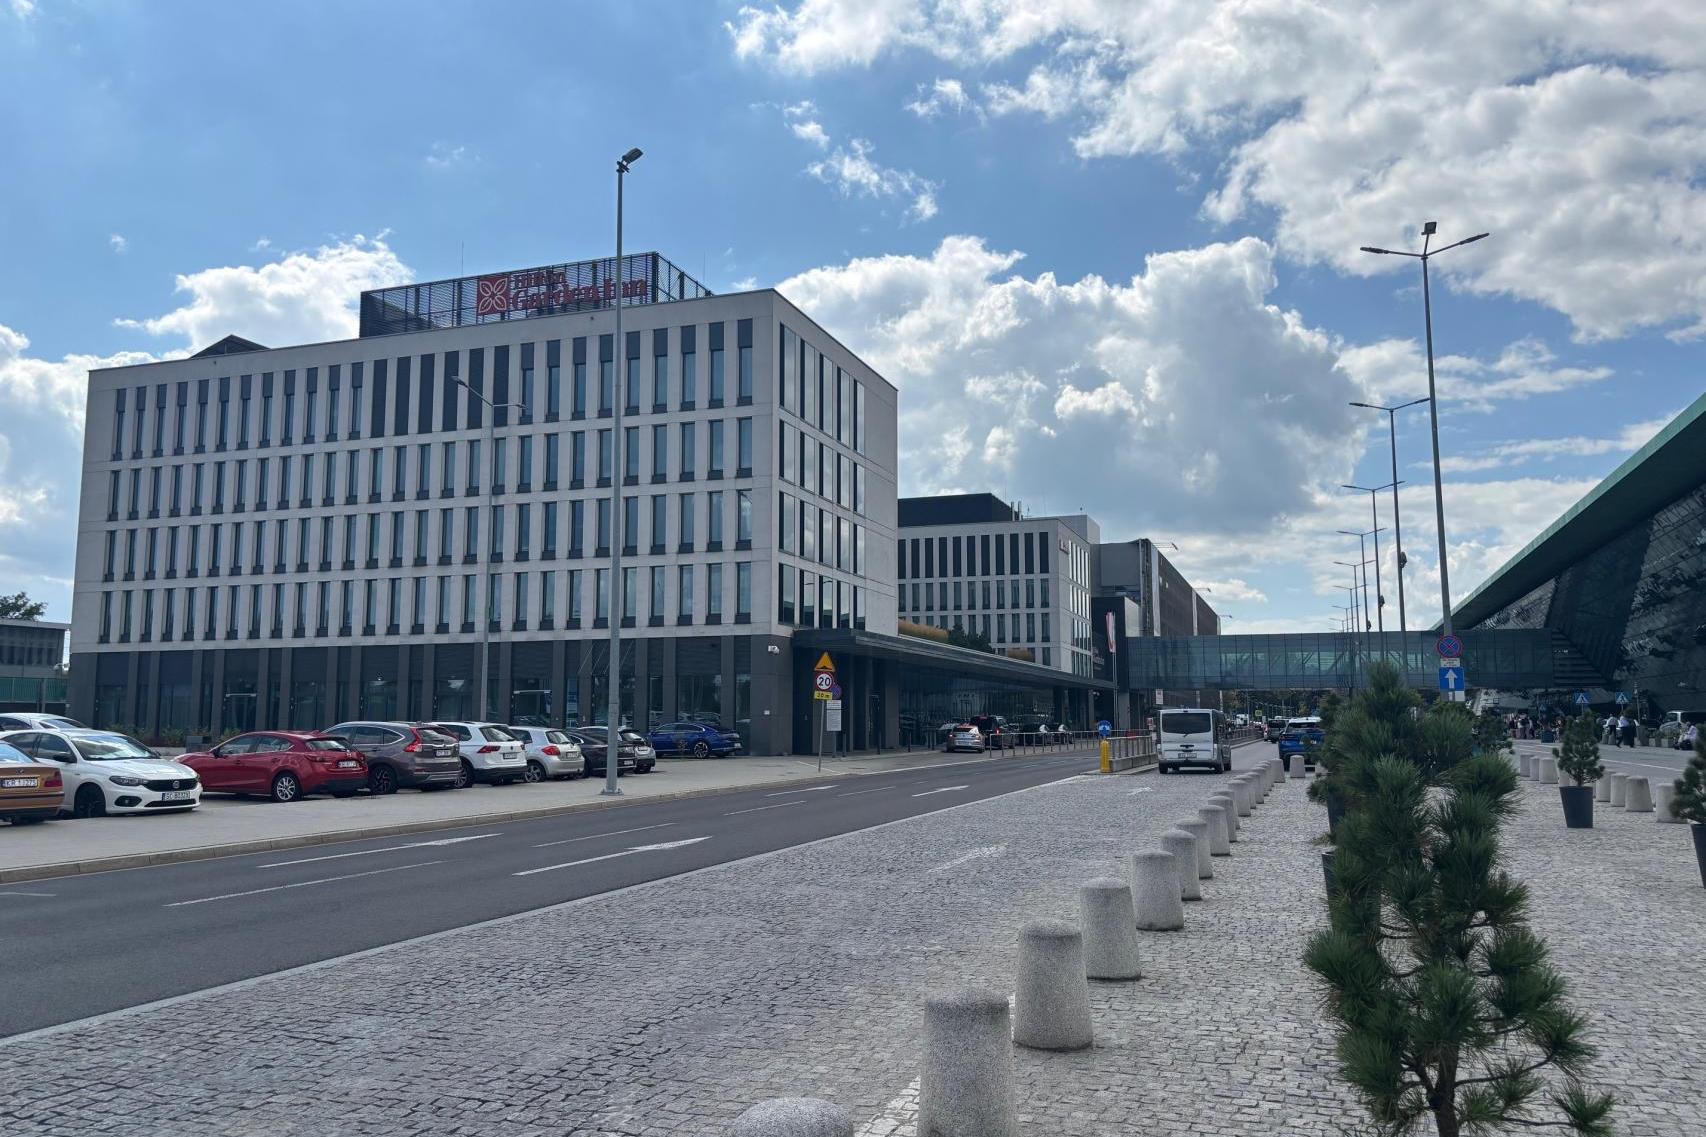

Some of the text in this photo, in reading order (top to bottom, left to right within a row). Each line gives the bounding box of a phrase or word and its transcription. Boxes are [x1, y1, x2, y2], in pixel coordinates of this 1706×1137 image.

[510, 271, 566, 289] Hilton
[511, 277, 648, 310] Garden Inn
[818, 676, 830, 686] 20
